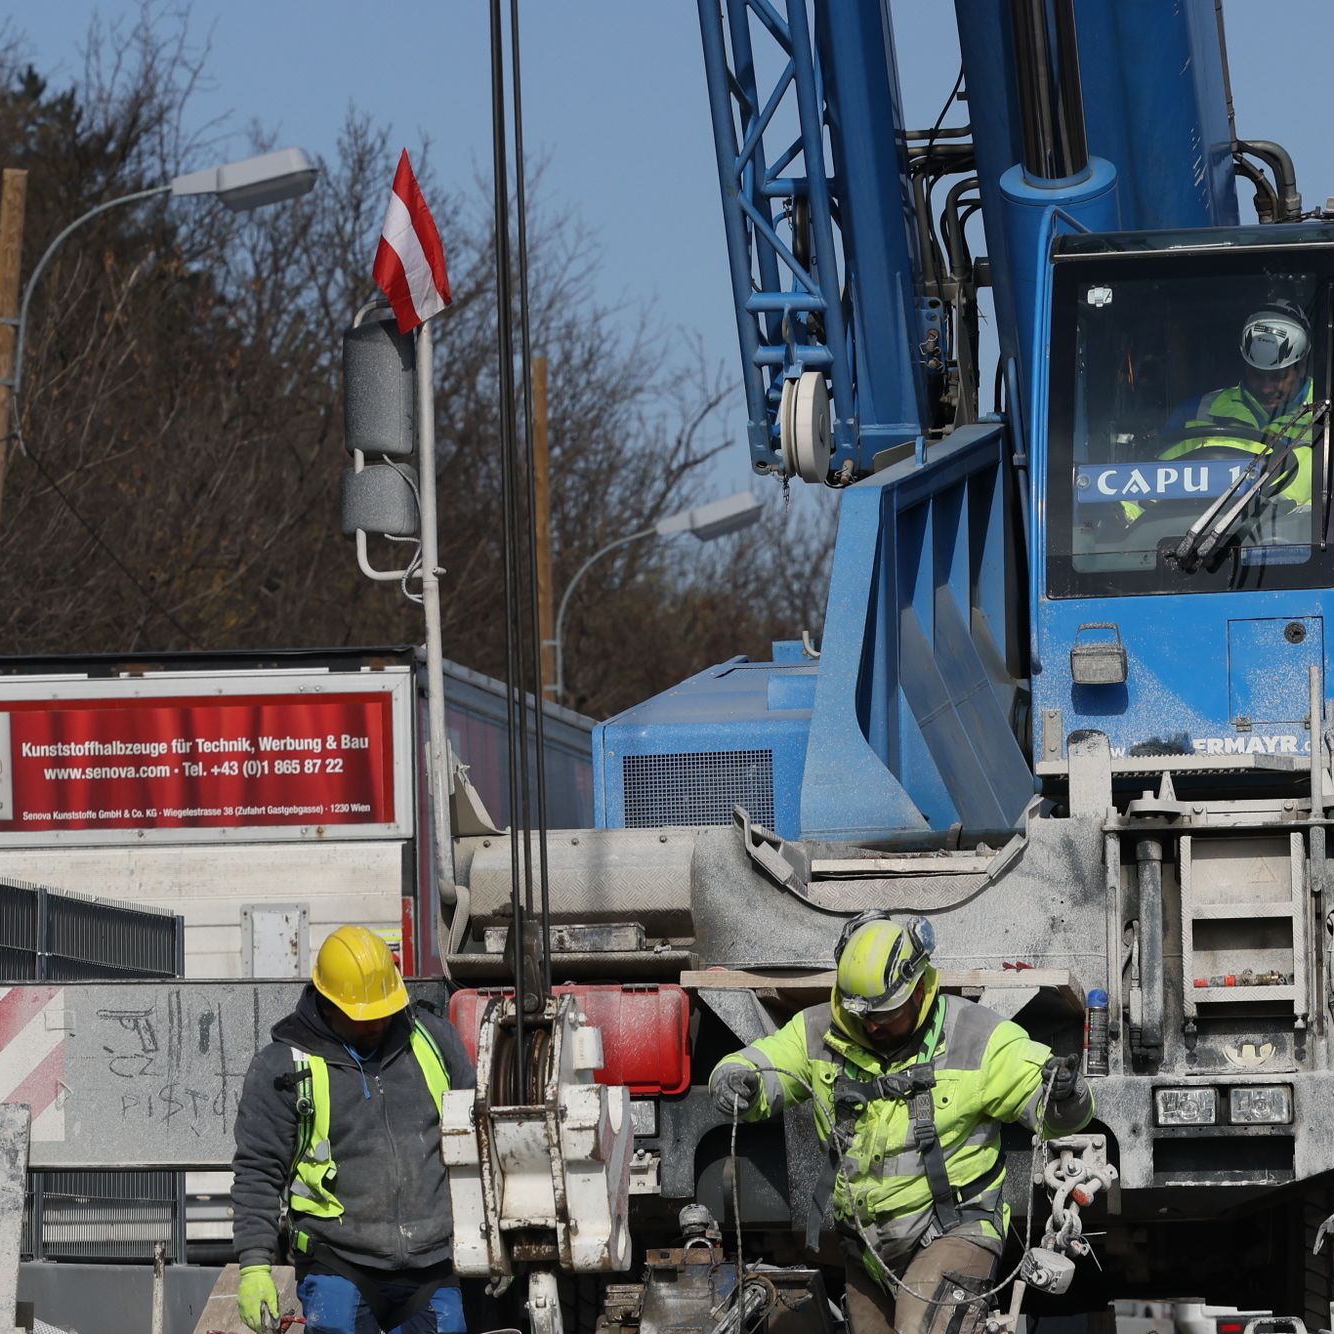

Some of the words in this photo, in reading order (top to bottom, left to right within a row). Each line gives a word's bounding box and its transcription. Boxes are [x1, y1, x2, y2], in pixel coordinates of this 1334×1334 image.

[1097, 466, 1209, 495] CAPU
[22, 740, 167, 757] Kunststoffhalbzeuge
[171, 738, 193, 753] für
[195, 737, 255, 754] Technik,
[258, 736, 322, 753] Werbung
[325, 734, 337, 750] &
[341, 734, 369, 749] Bau
[44, 765, 170, 781] www.senova.com
[182, 761, 207, 777] Tel.
[210, 760, 239, 777] +43
[242, 760, 269, 778] (0)1
[274, 759, 301, 775] 865
[304, 759, 322, 774] 87
[325, 758, 344, 773] 22
[23, 811, 51, 821] Senova
[53, 810, 96, 820] Kunststoffe
[98, 809, 121, 819] GmbH
[146, 808, 157, 817] KG
[330, 803, 349, 813] 1230
[351, 803, 371, 812] Wien
